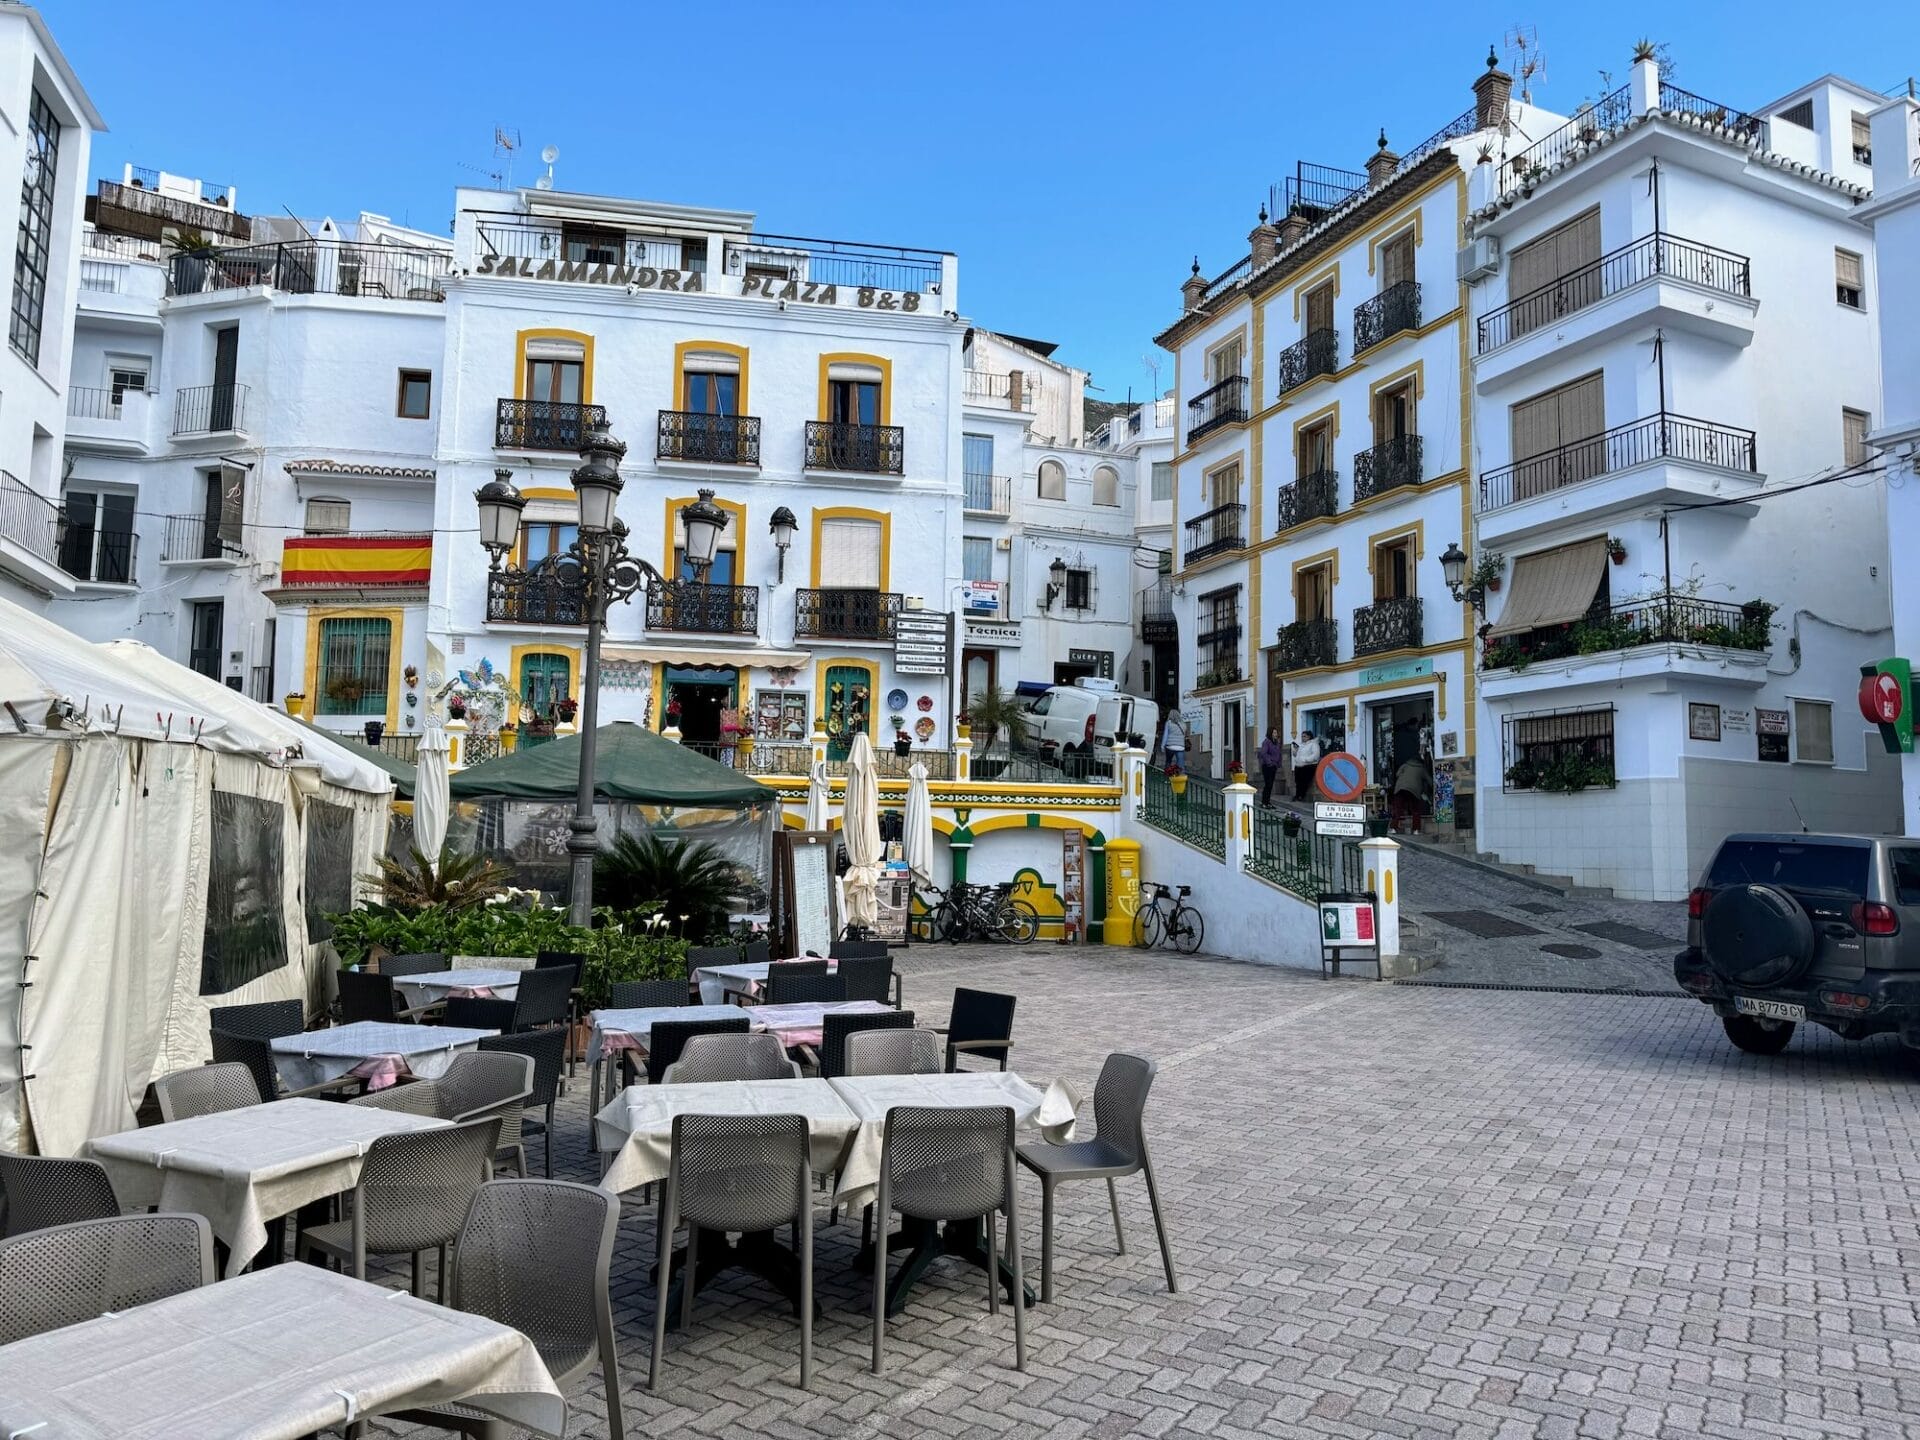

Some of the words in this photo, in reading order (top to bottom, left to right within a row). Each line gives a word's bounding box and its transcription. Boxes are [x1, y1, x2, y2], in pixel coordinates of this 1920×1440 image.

[477, 254, 703, 292] SALAMANDRA
[741, 275, 837, 305] PLAZA
[857, 287, 921, 312] B&B
[967, 626, 1021, 637] Técnica:
[1742, 1000, 1757, 1012] MA
[1758, 1001, 1788, 1016] 8779
[1789, 1006, 1804, 1018] CY
